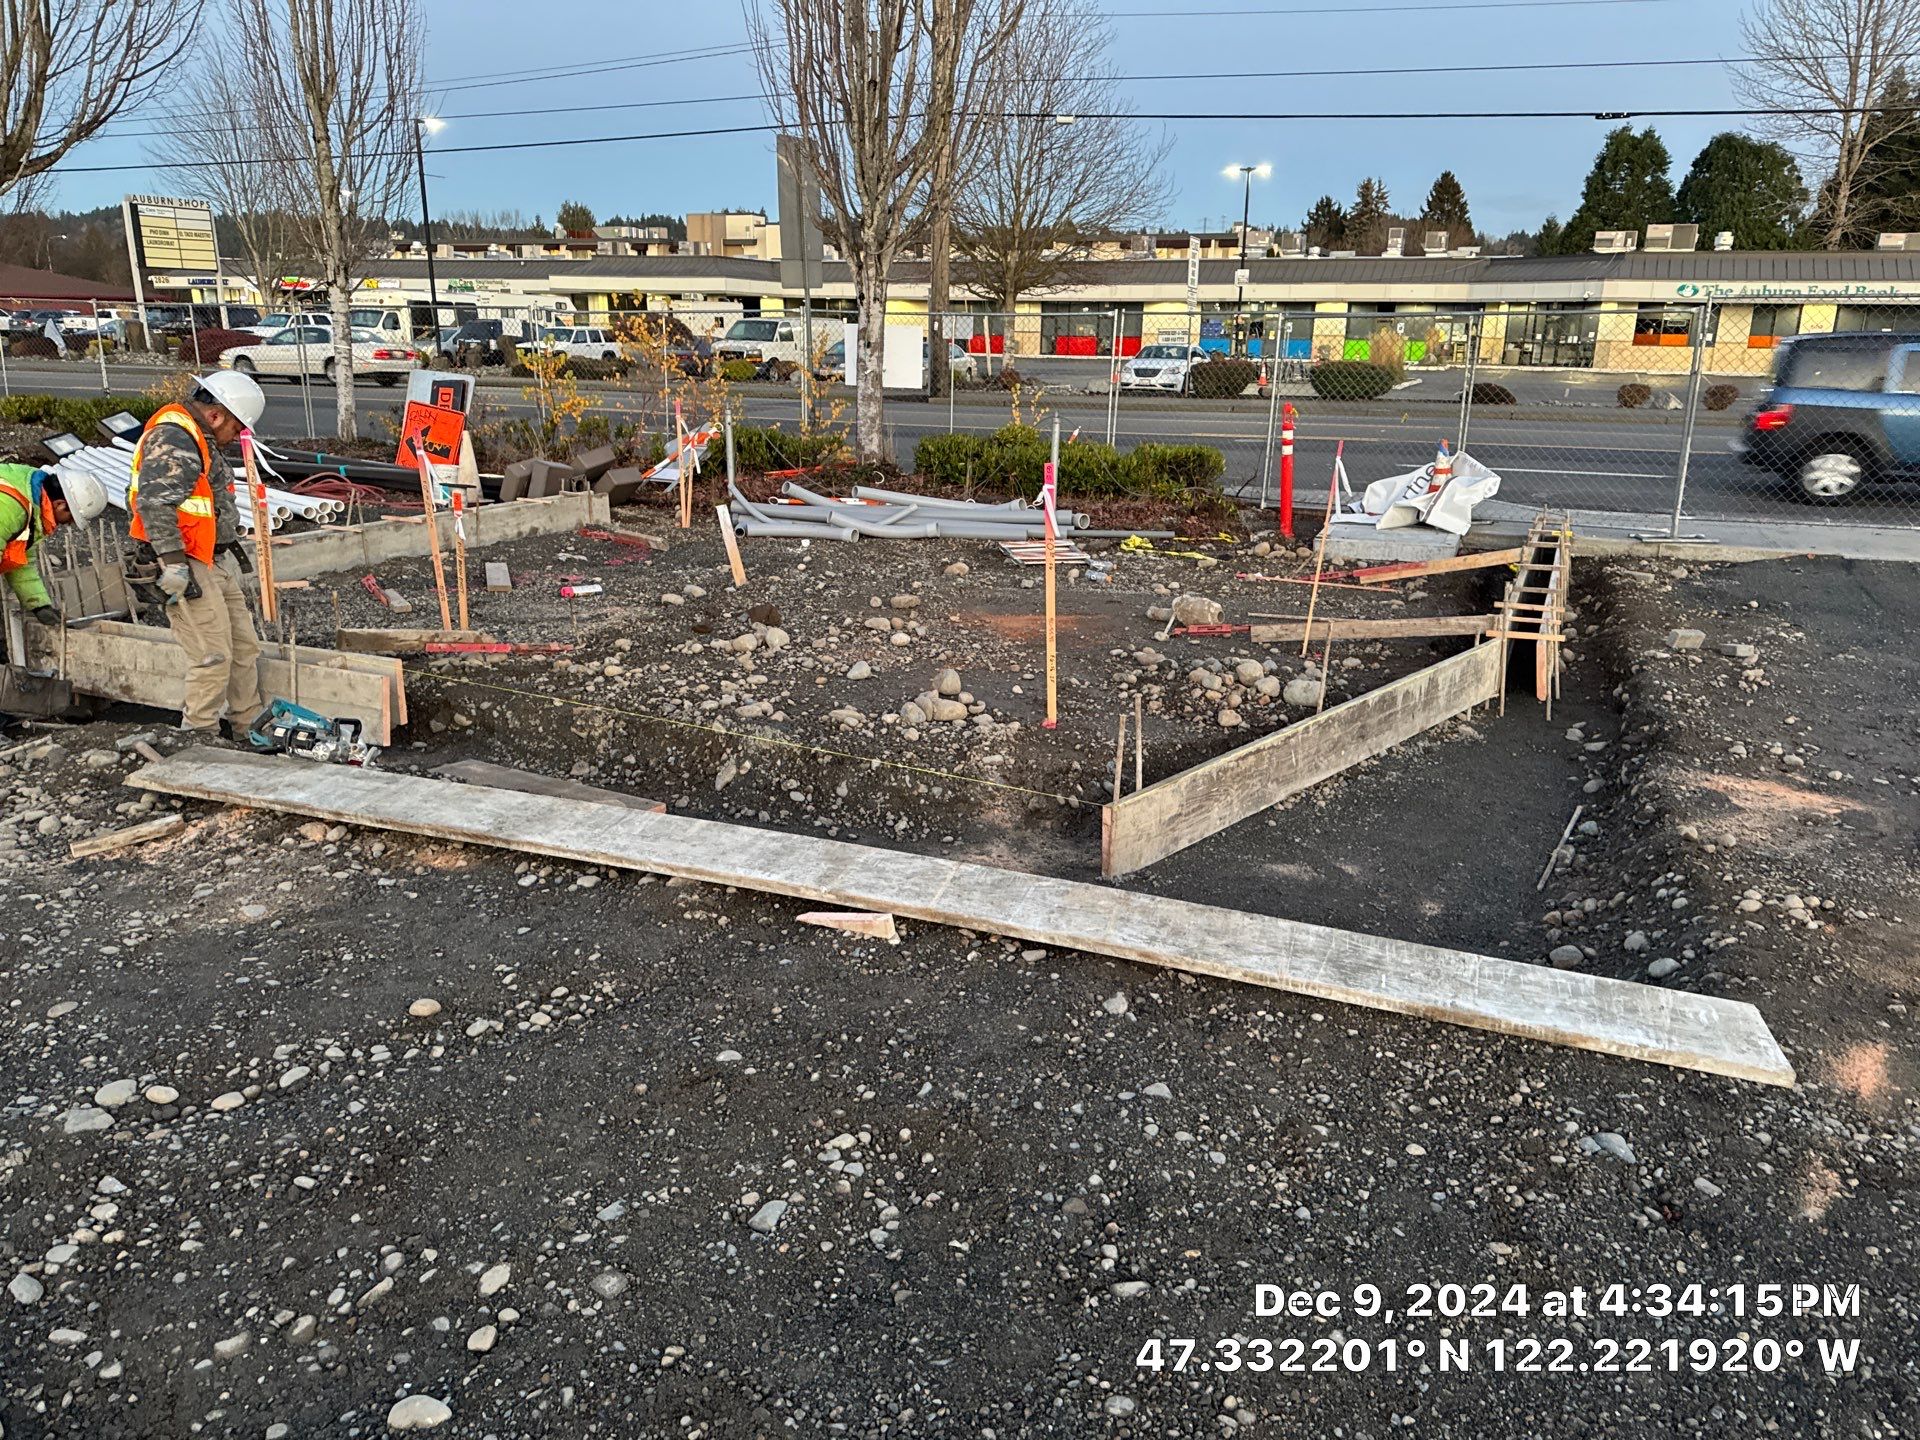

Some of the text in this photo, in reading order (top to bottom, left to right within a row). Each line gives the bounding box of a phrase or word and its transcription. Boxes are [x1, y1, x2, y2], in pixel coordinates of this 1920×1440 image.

[132, 194, 211, 208] AUBURN SHOPS
[1702, 284, 1733, 296] The
[1740, 284, 1802, 297] Auburn
[1806, 285, 1850, 297] Food
